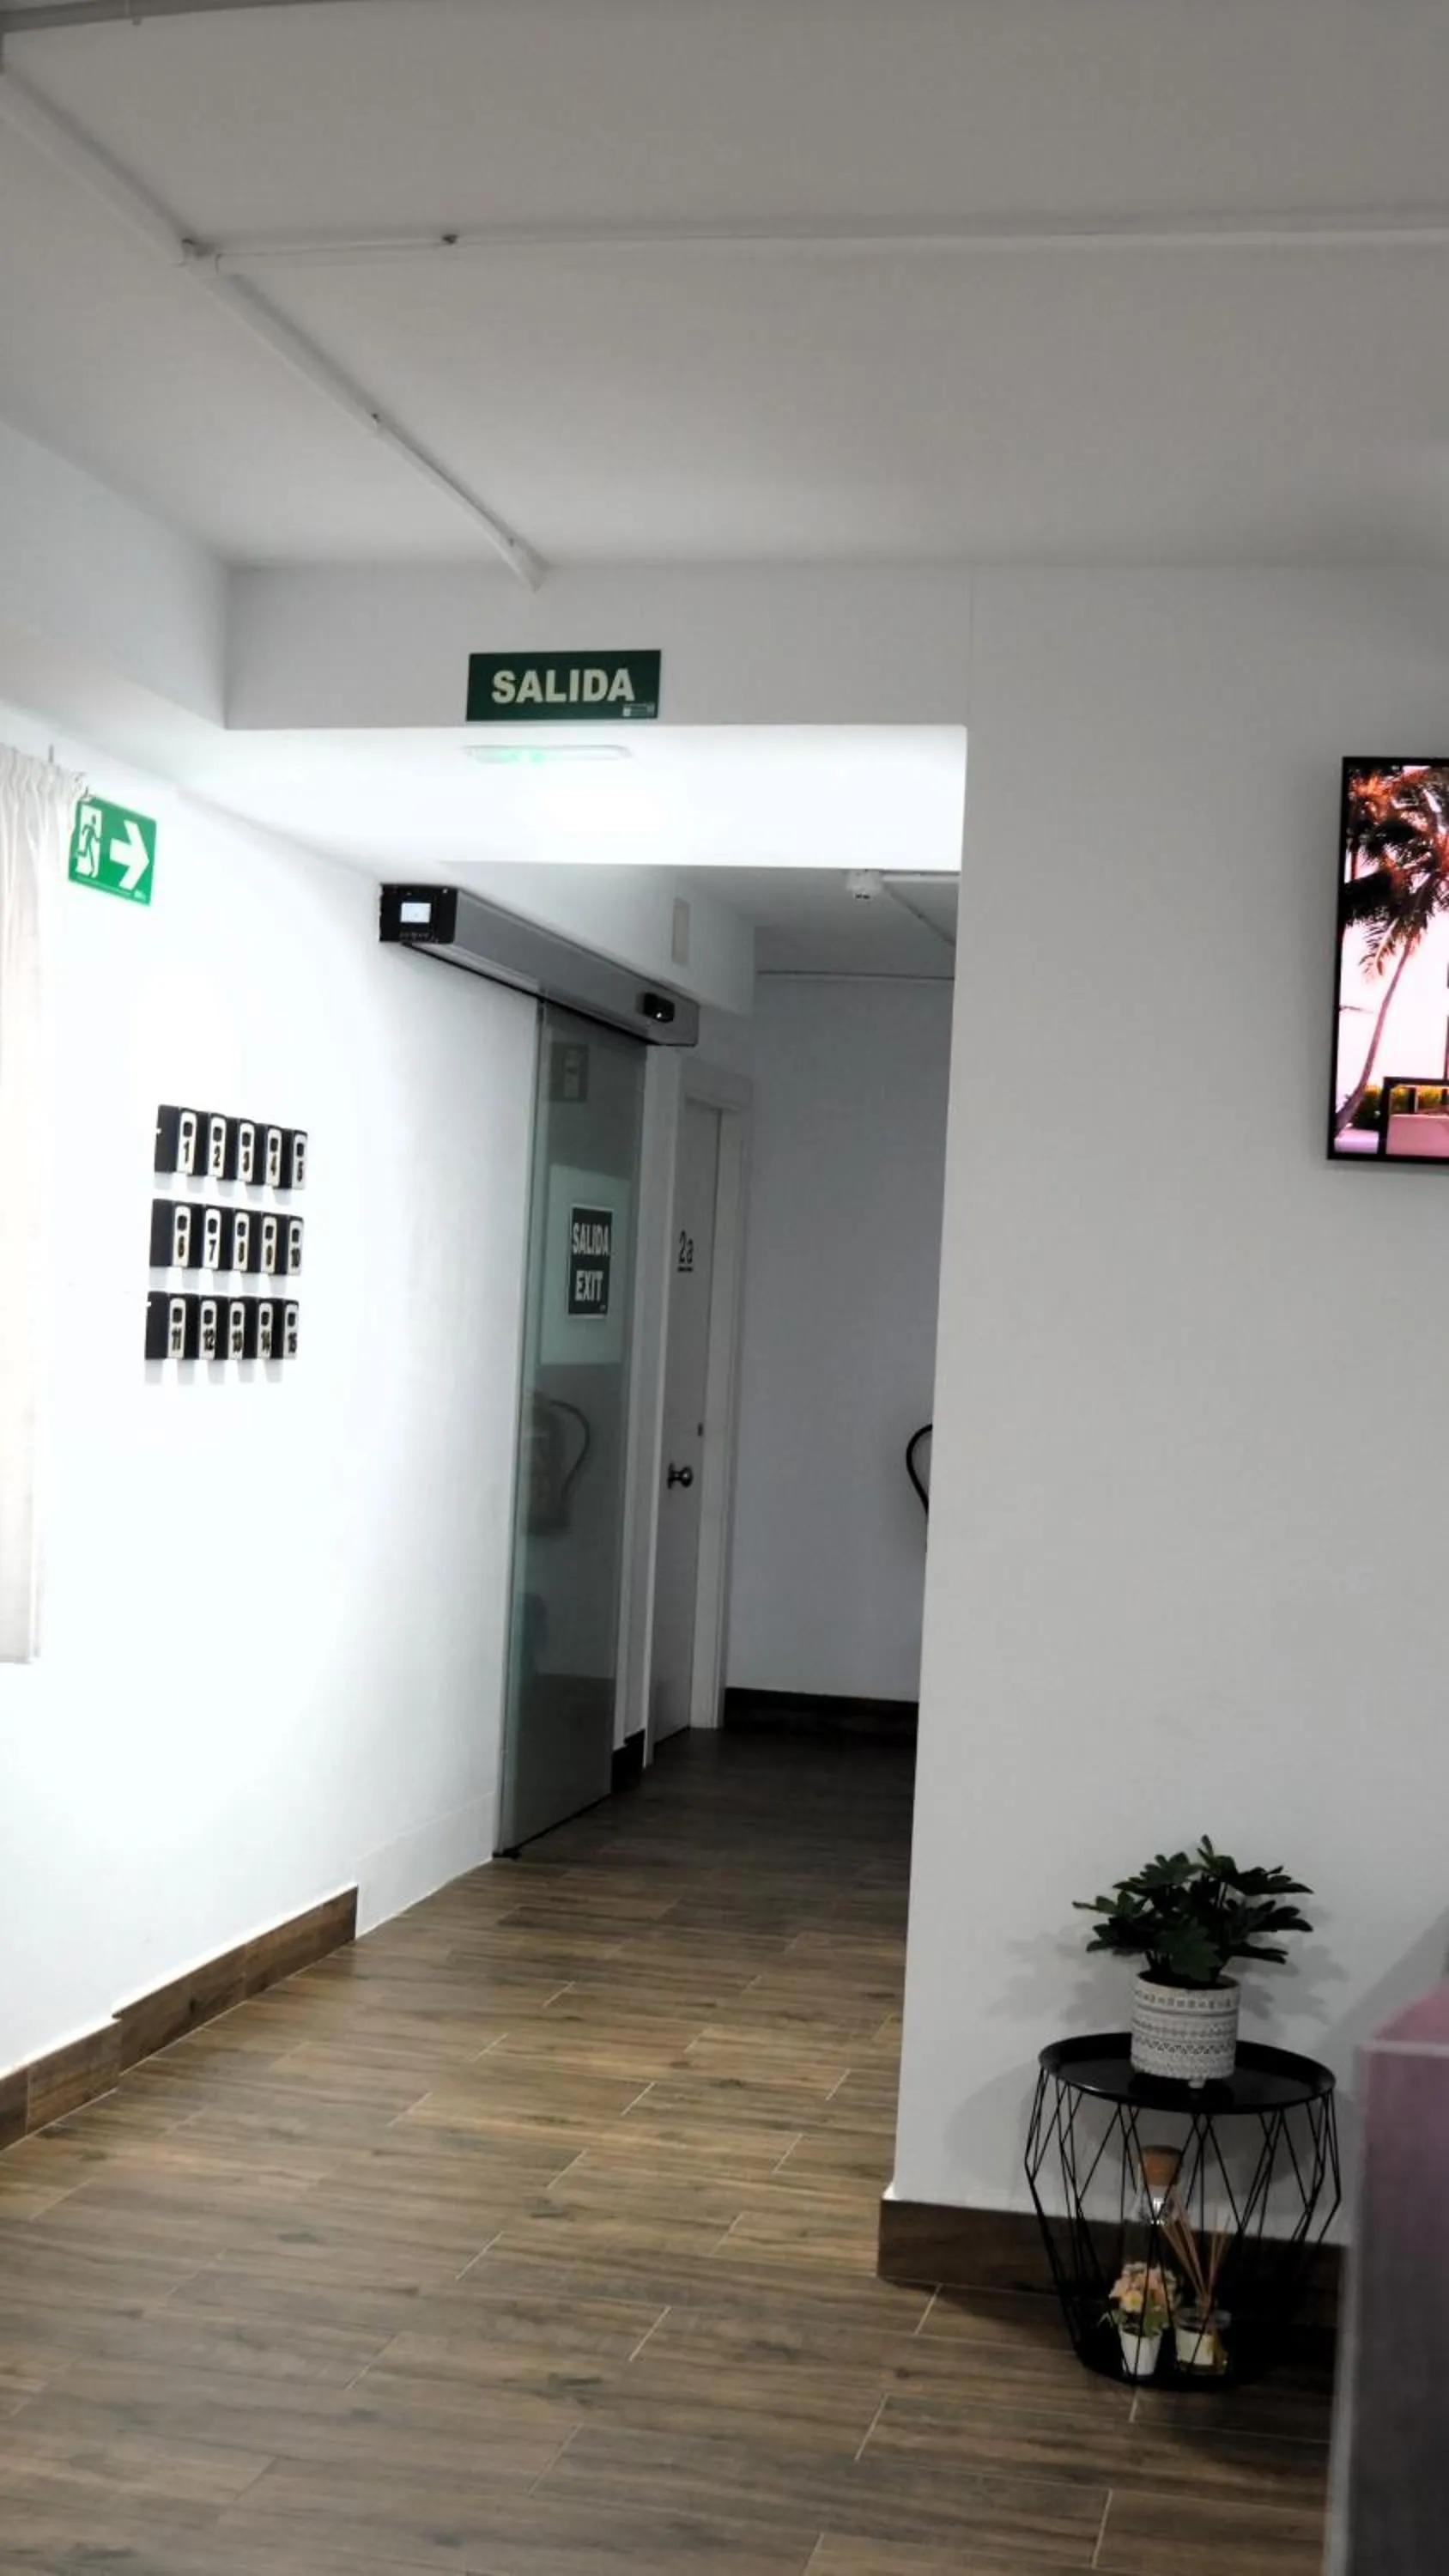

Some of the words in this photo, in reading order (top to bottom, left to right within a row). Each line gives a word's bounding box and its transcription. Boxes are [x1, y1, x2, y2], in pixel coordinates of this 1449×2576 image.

[491, 668, 635, 703] SALIDA
[183, 1139, 190, 1164] 1
[213, 1145, 221, 1169] 2
[270, 1155, 277, 1176] 4
[209, 1239, 216, 1262] 7
[573, 1222, 609, 1255] SALIDA
[575, 1270, 603, 1301] EXIT
[172, 1327, 182, 1351] 11
[203, 1328, 215, 1352] 12
